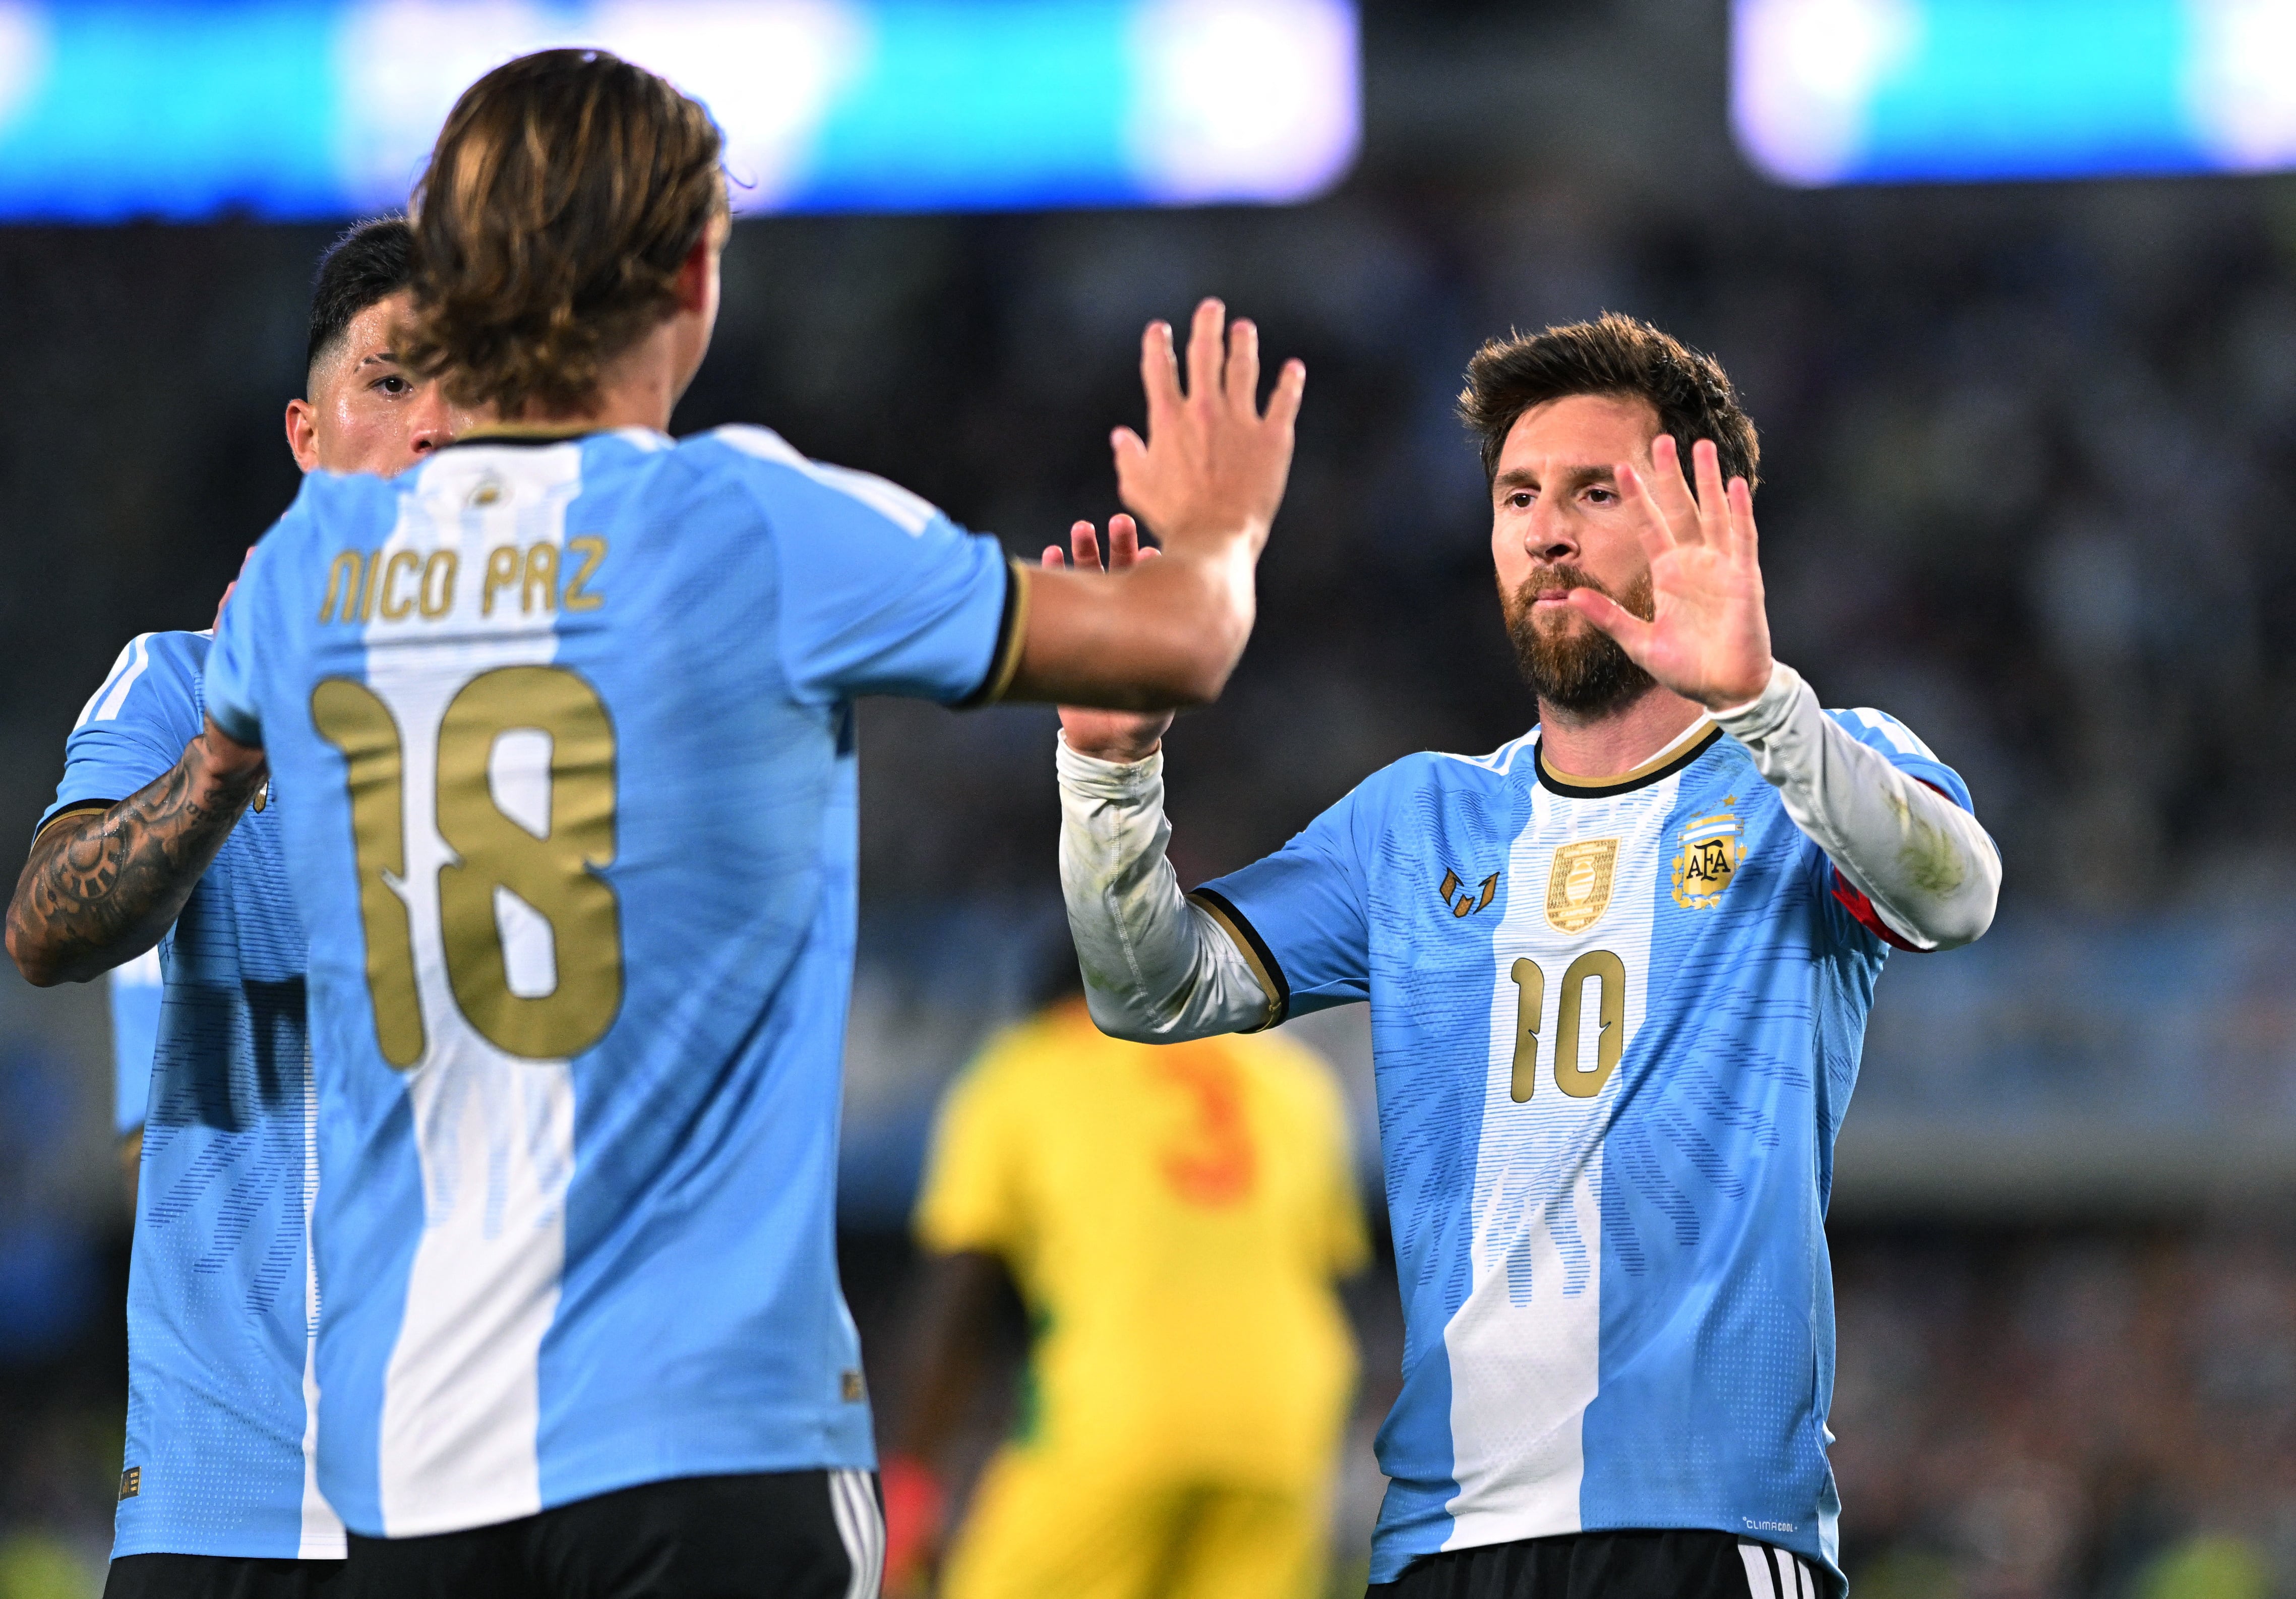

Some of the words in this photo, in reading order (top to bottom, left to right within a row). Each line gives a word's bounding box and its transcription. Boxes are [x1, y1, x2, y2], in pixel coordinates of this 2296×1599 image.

[320, 548, 458, 623] NICO
[482, 536, 607, 617] PAZ
[310, 664, 624, 1070] 18
[1686, 839, 1730, 881] AFA
[1511, 950, 1625, 1102] 10
